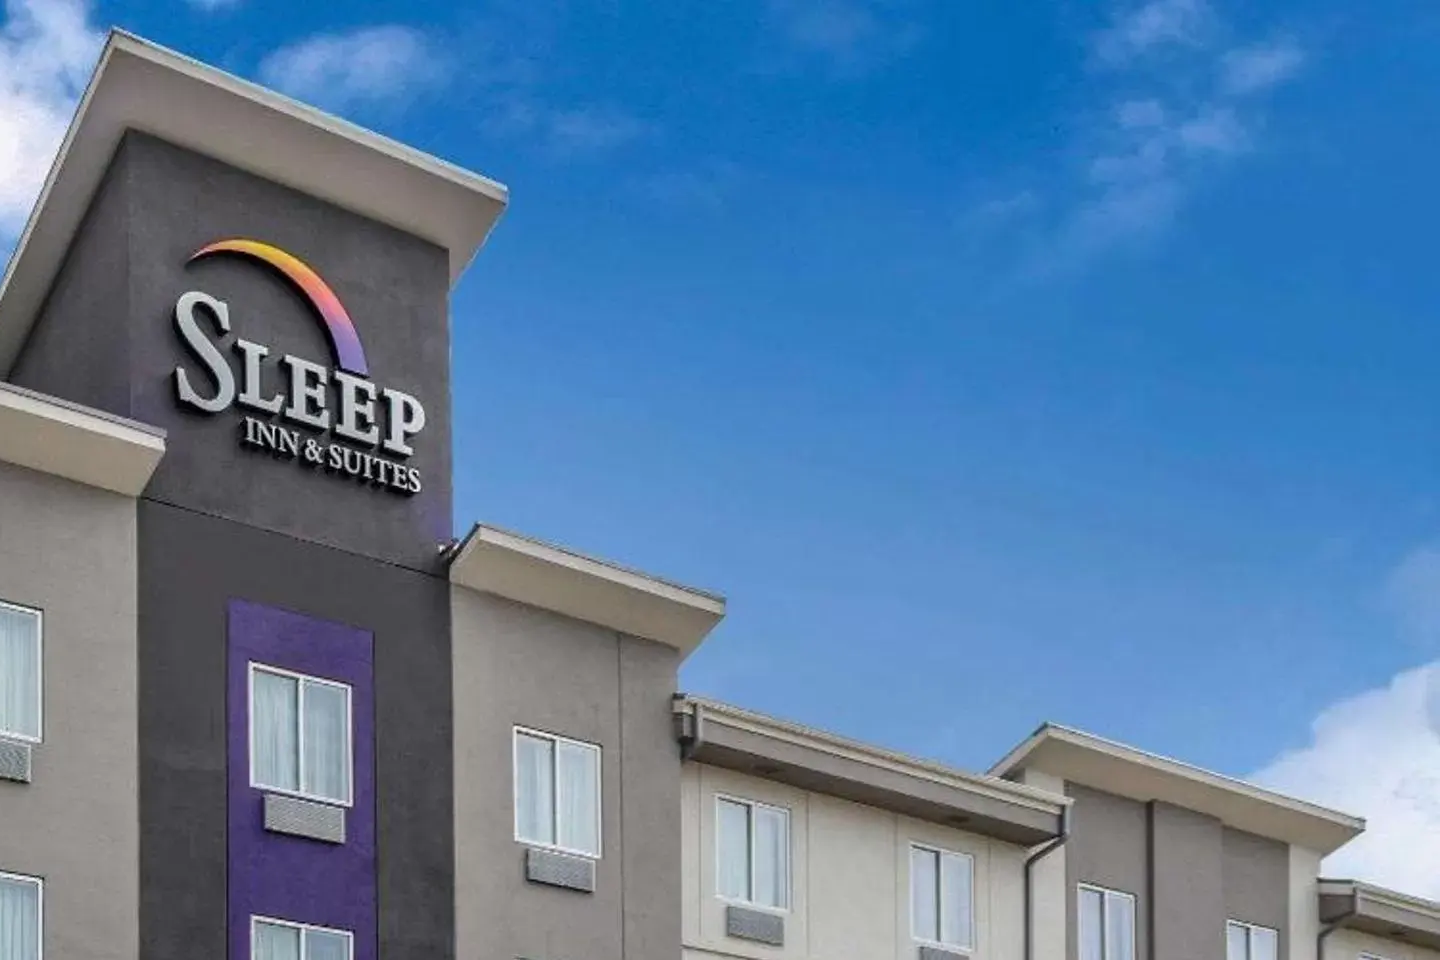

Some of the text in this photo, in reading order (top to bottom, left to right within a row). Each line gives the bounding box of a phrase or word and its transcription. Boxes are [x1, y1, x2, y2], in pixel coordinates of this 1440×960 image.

[174, 290, 426, 457] SLEEP
[243, 415, 423, 494] INN & SUITES
